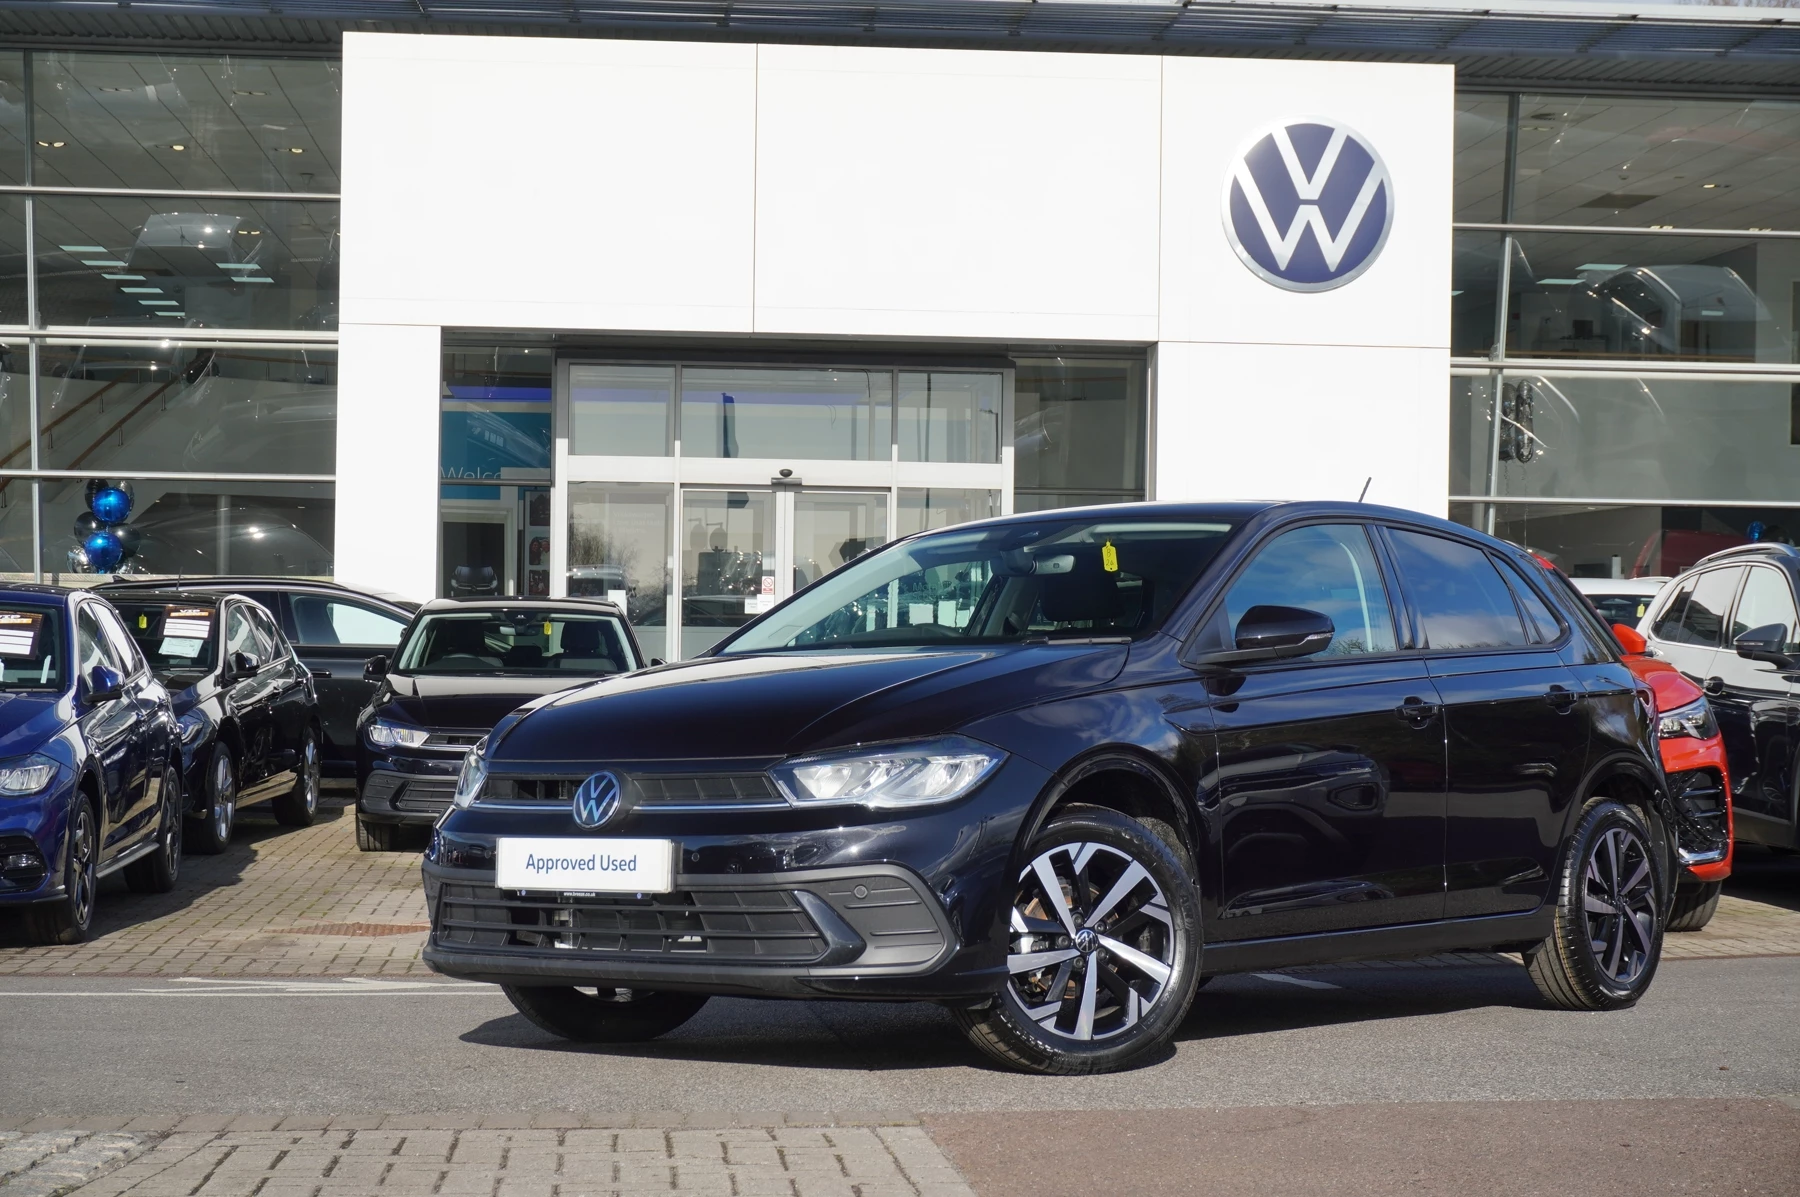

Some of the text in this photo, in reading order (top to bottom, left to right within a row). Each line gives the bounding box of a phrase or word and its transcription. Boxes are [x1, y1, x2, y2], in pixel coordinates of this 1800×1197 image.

[1231, 122, 1388, 277] VW
[577, 772, 619, 823] VW
[525, 853, 637, 875] Approved Used
